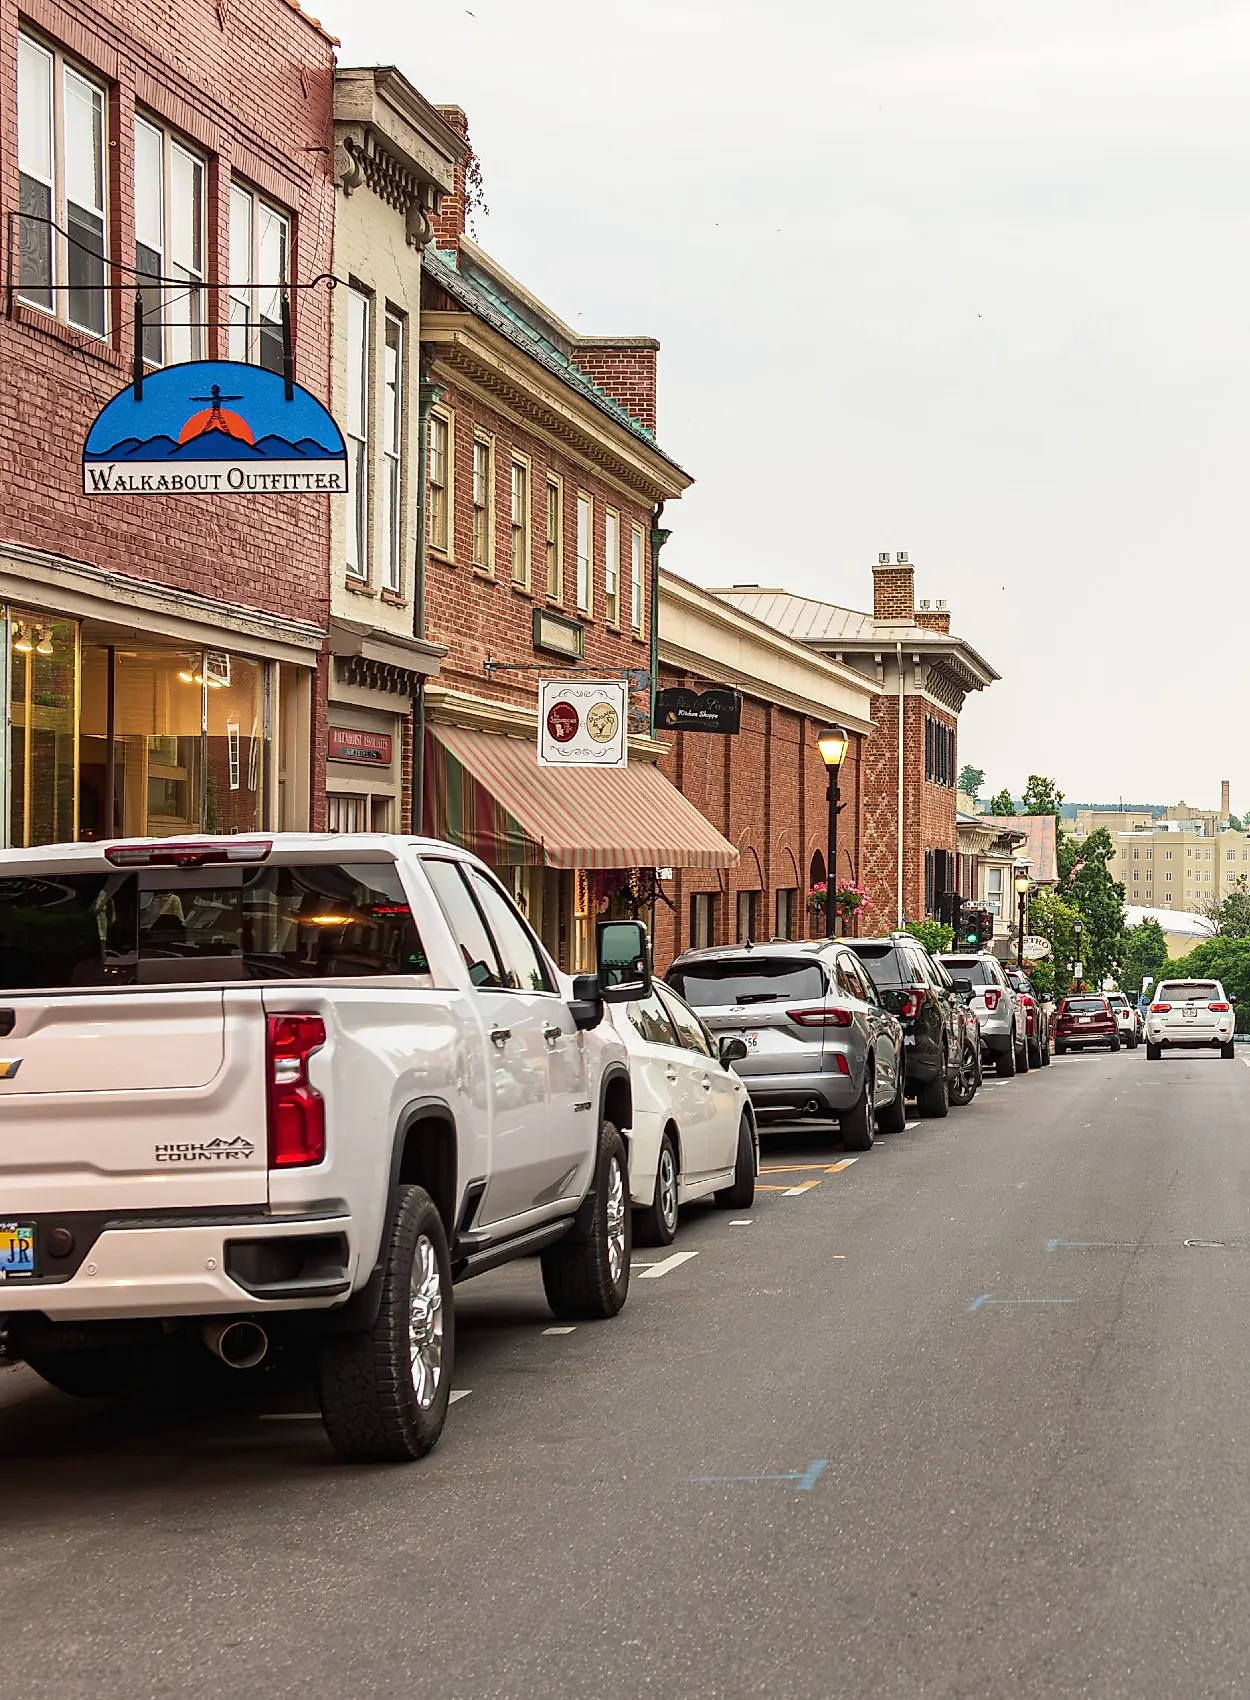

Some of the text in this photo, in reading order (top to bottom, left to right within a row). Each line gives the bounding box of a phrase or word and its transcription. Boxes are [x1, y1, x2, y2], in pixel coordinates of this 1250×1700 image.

[88, 464, 342, 492] WALKABOUT OUTFITTER
[155, 1143, 204, 1153] HIGH
[155, 1151, 255, 1162] COUNTRY
